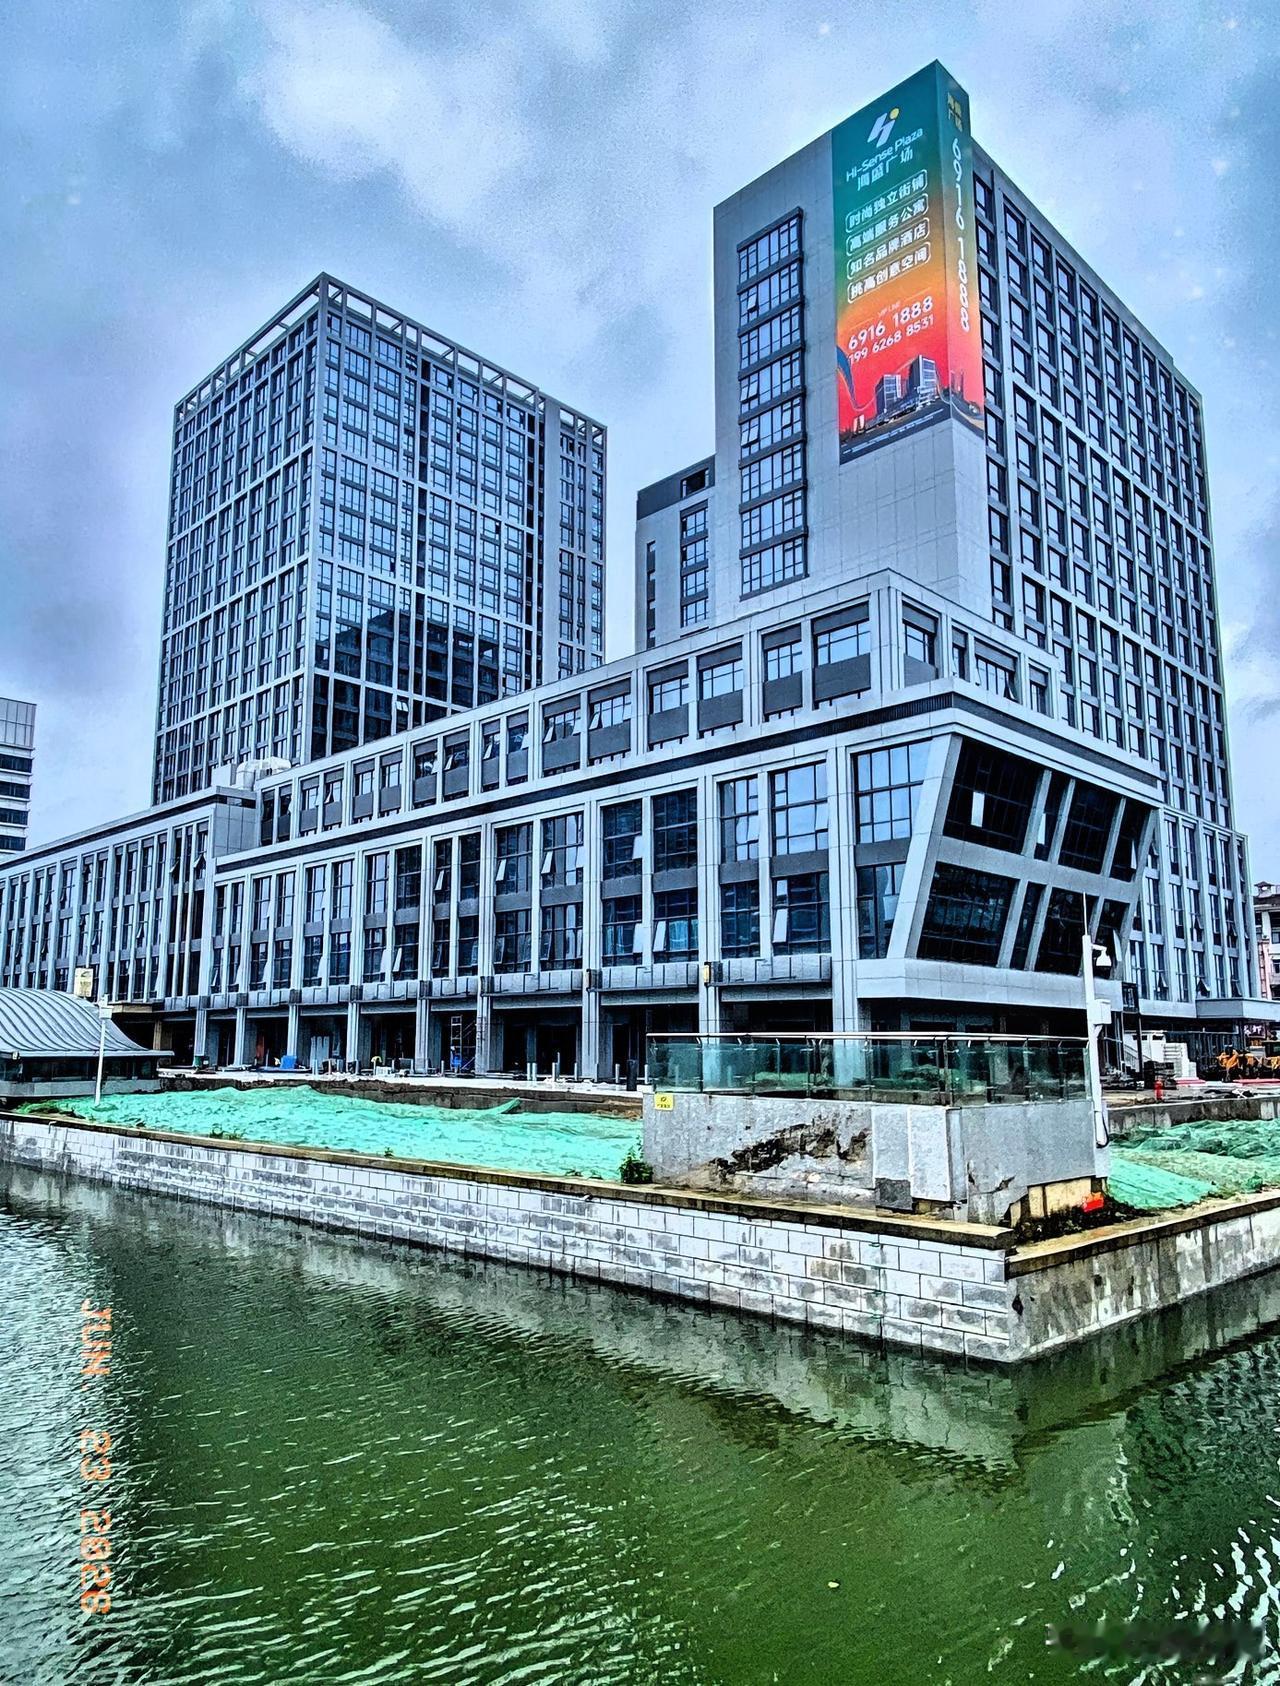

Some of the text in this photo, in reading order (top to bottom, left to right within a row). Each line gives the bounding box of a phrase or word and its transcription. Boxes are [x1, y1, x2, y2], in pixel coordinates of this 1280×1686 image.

[846, 128, 924, 183] Hi-Sense Plaza
[849, 174, 924, 229] 时尚独立街铺
[952, 138, 965, 231] 6916
[850, 198, 925, 251] 高端服务公寓
[850, 222, 927, 276] 知名品牌酒店
[850, 247, 928, 300] 挑高创意空间
[957, 236, 970, 333] 1888
[848, 314, 934, 366] 199 6268 8531
[849, 295, 933, 350] 6916 1888
